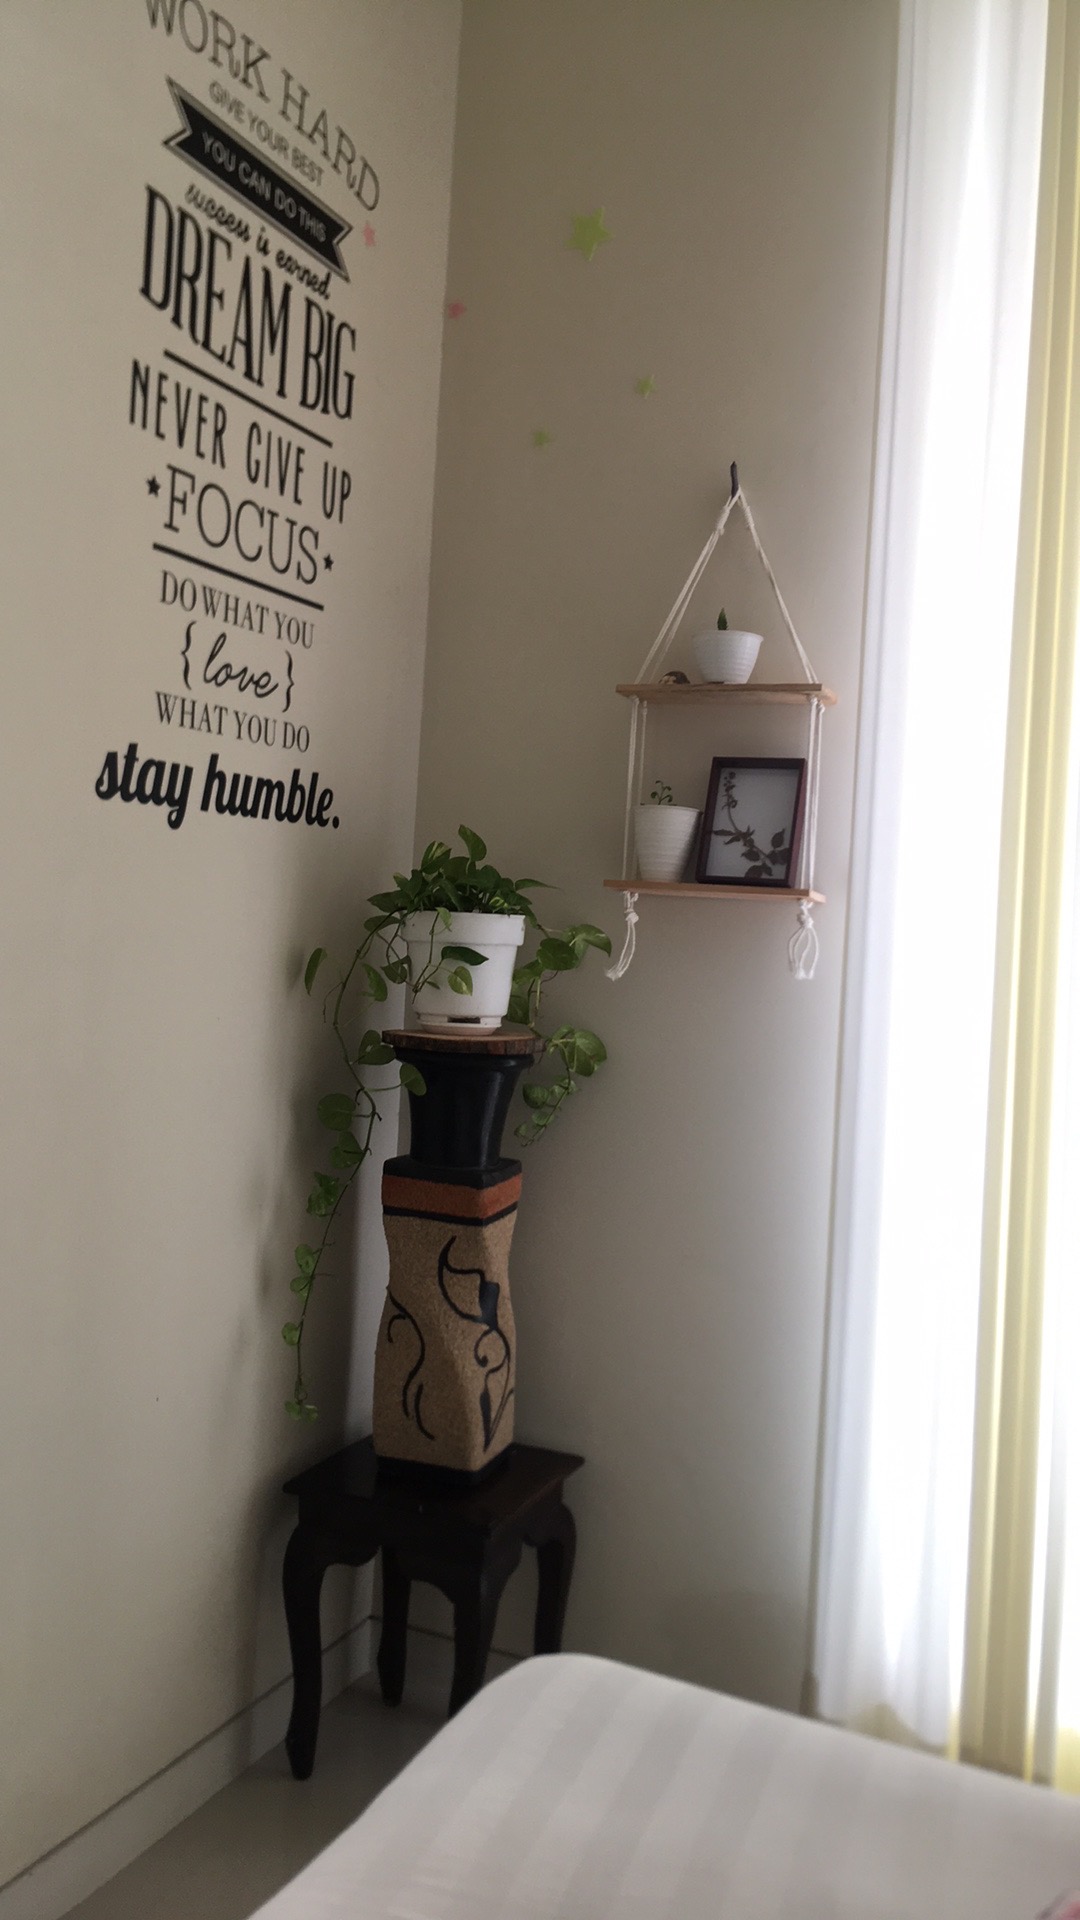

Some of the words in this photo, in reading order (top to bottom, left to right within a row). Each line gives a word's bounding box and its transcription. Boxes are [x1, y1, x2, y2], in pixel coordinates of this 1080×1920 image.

[202, 130, 237, 172] YOU
[238, 160, 272, 201] CAN
[274, 186, 298, 219] DO
[298, 206, 328, 243] THIS
[209, 80, 245, 124] GIVE
[248, 110, 289, 160] YOUR
[291, 146, 325, 187] BEST
[278, 67, 381, 212] HARD
[184, 183, 251, 243] success
[256, 225, 270, 256] is
[139, 183, 293, 400] DREAM
[299, 295, 357, 420] BIG
[129, 358, 227, 470] NEVER
[246, 421, 305, 506] GIVE
[322, 460, 352, 525] UP
[163, 463, 319, 585] FOCUS
[160, 569, 198, 613] DO
[201, 584, 270, 636] WHAT
[274, 610, 315, 650] YOU
[155, 691, 229, 736] WHAT
[233, 709, 277, 748] YOU
[282, 721, 311, 753] DO
[95, 742, 194, 831] stay
[199, 752, 341, 830] humble.
